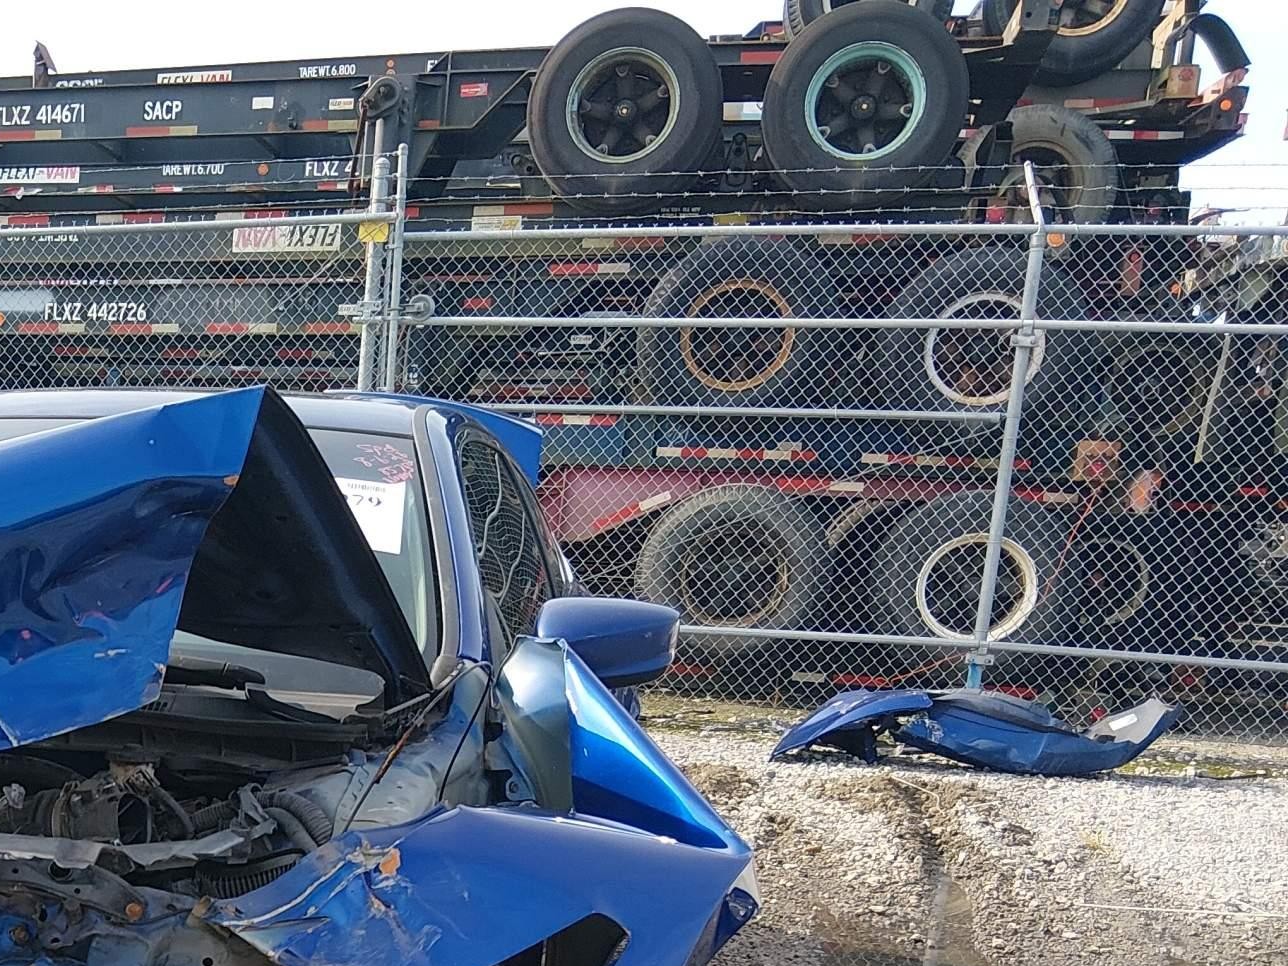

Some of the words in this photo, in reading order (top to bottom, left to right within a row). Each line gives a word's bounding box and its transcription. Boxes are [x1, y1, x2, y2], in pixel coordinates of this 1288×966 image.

[35, 103, 85, 124] 414671
[143, 101, 182, 121] SACP
[305, 160, 339, 177] FLXZ
[44, 302, 81, 321] FLXZ
[87, 302, 147, 321] 442726
